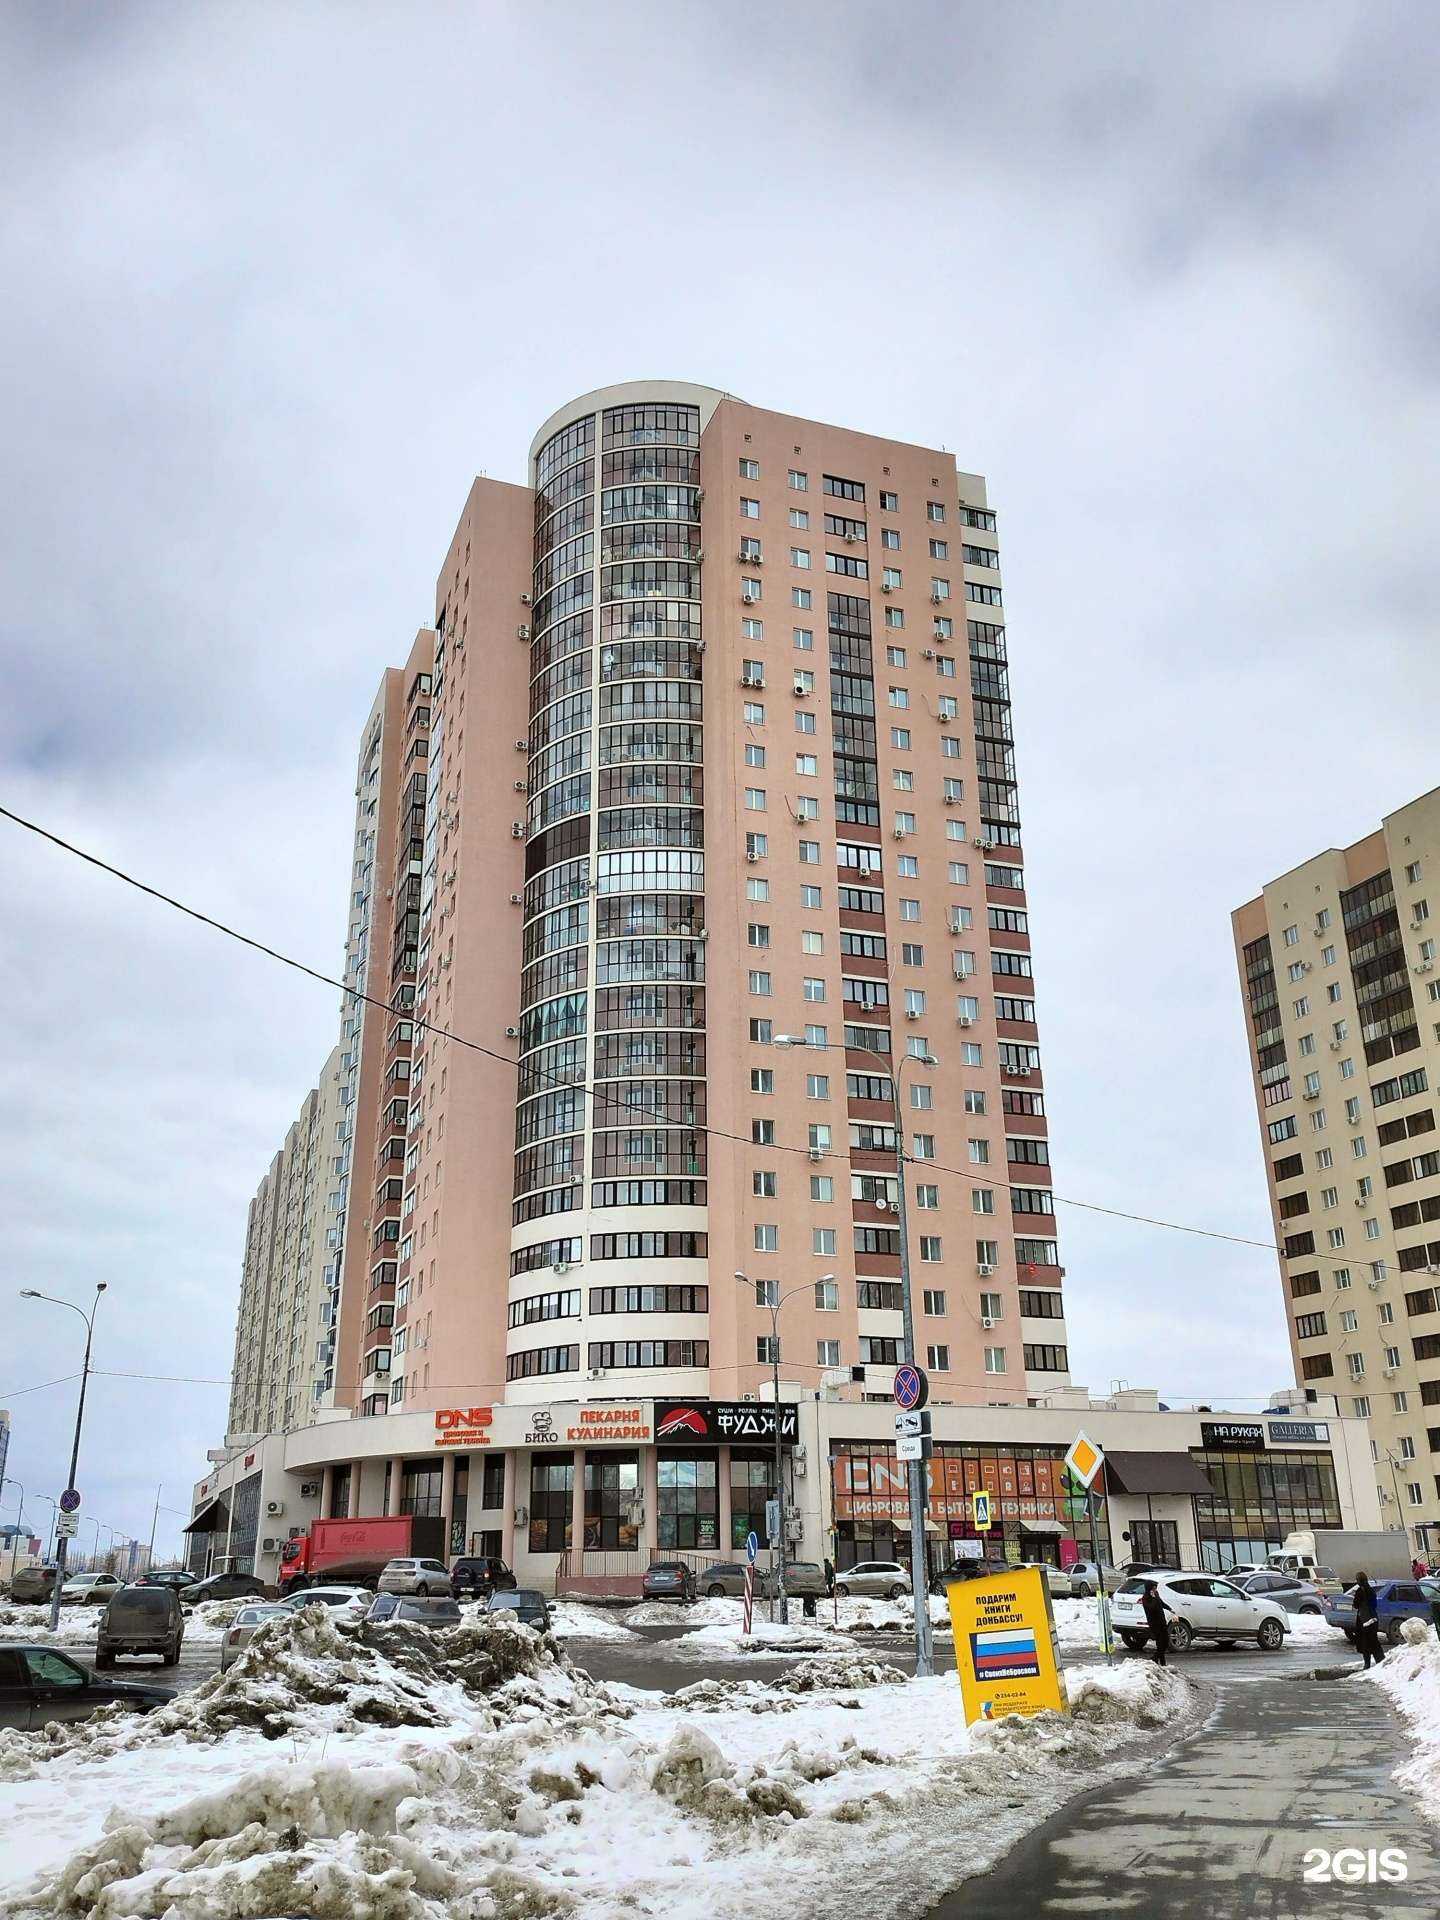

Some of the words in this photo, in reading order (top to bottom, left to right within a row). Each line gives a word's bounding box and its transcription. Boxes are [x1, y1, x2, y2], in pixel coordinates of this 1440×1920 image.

[435, 1407, 493, 1429] DNS
[580, 1410, 640, 1423] ПЕКАРНЯ
[718, 1415, 796, 1436] ФУДЖИ
[1214, 1426, 1228, 1436] НА
[1231, 1427, 1263, 1437] РУКАХ
[1271, 1424, 1315, 1435] GALLERIA
[525, 1432, 559, 1444] БИКО
[567, 1426, 650, 1441] КУЛИНАРИЯ
[976, 1593, 1017, 1605] ПОДАРИМ
[984, 1604, 1011, 1615] КНИГИ
[976, 1614, 1024, 1627] ДОНБАССУ!
